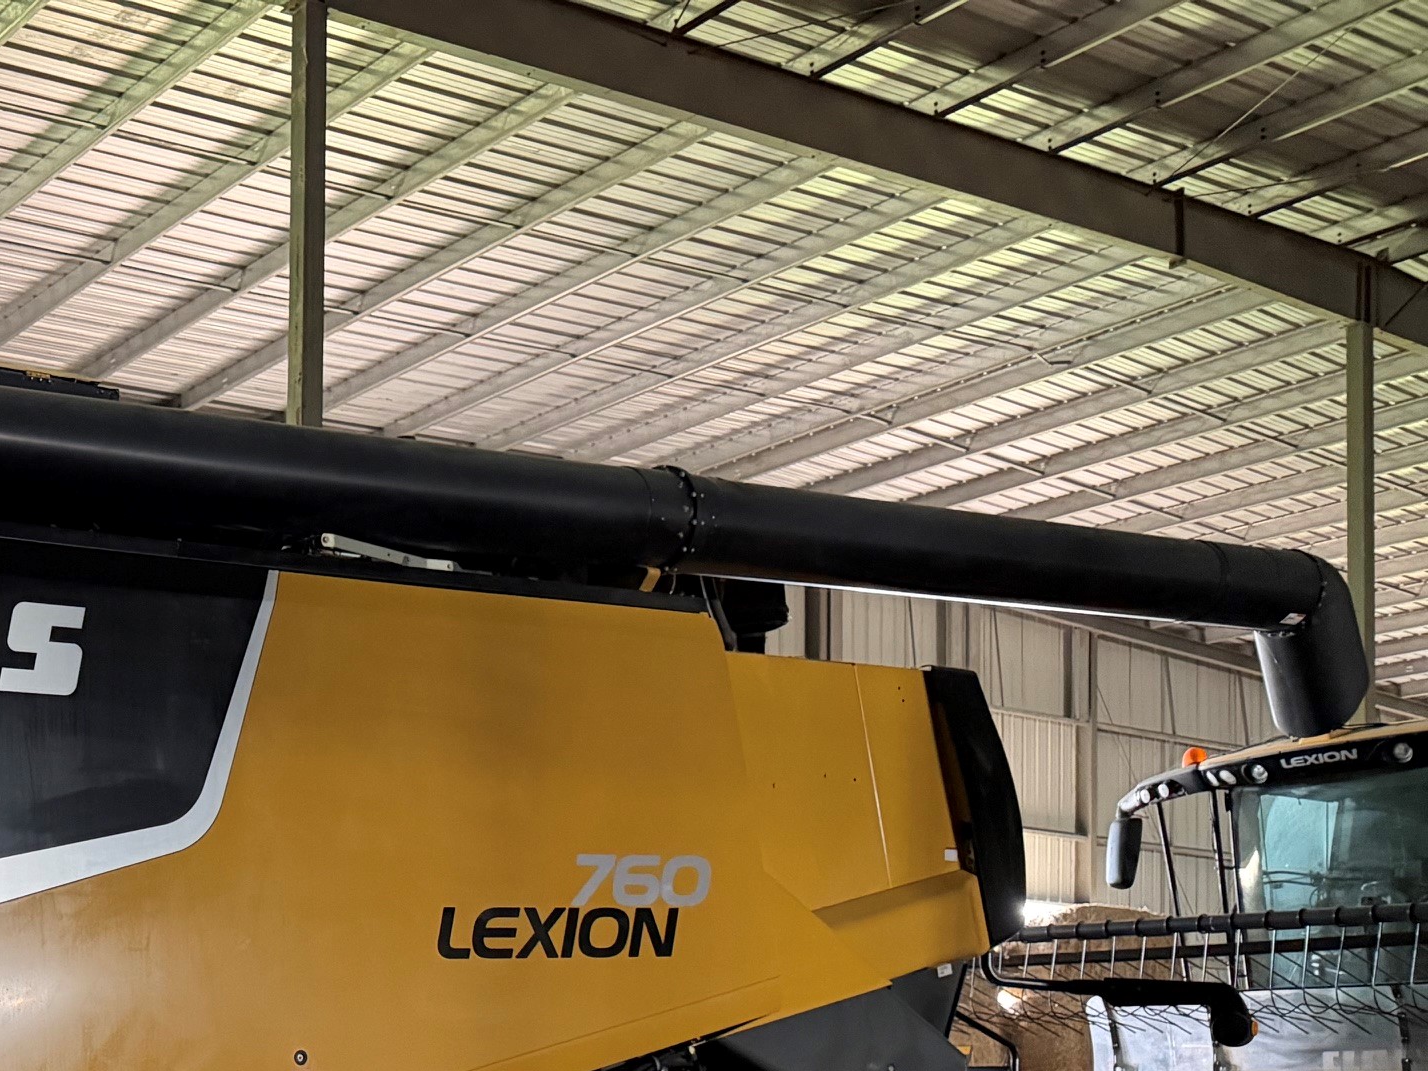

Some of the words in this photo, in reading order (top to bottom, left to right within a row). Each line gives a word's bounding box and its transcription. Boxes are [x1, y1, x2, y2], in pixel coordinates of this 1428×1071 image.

[1280, 748, 1358, 769] LEXION
[570, 854, 712, 907] 760
[437, 907, 679, 959] LEXION
